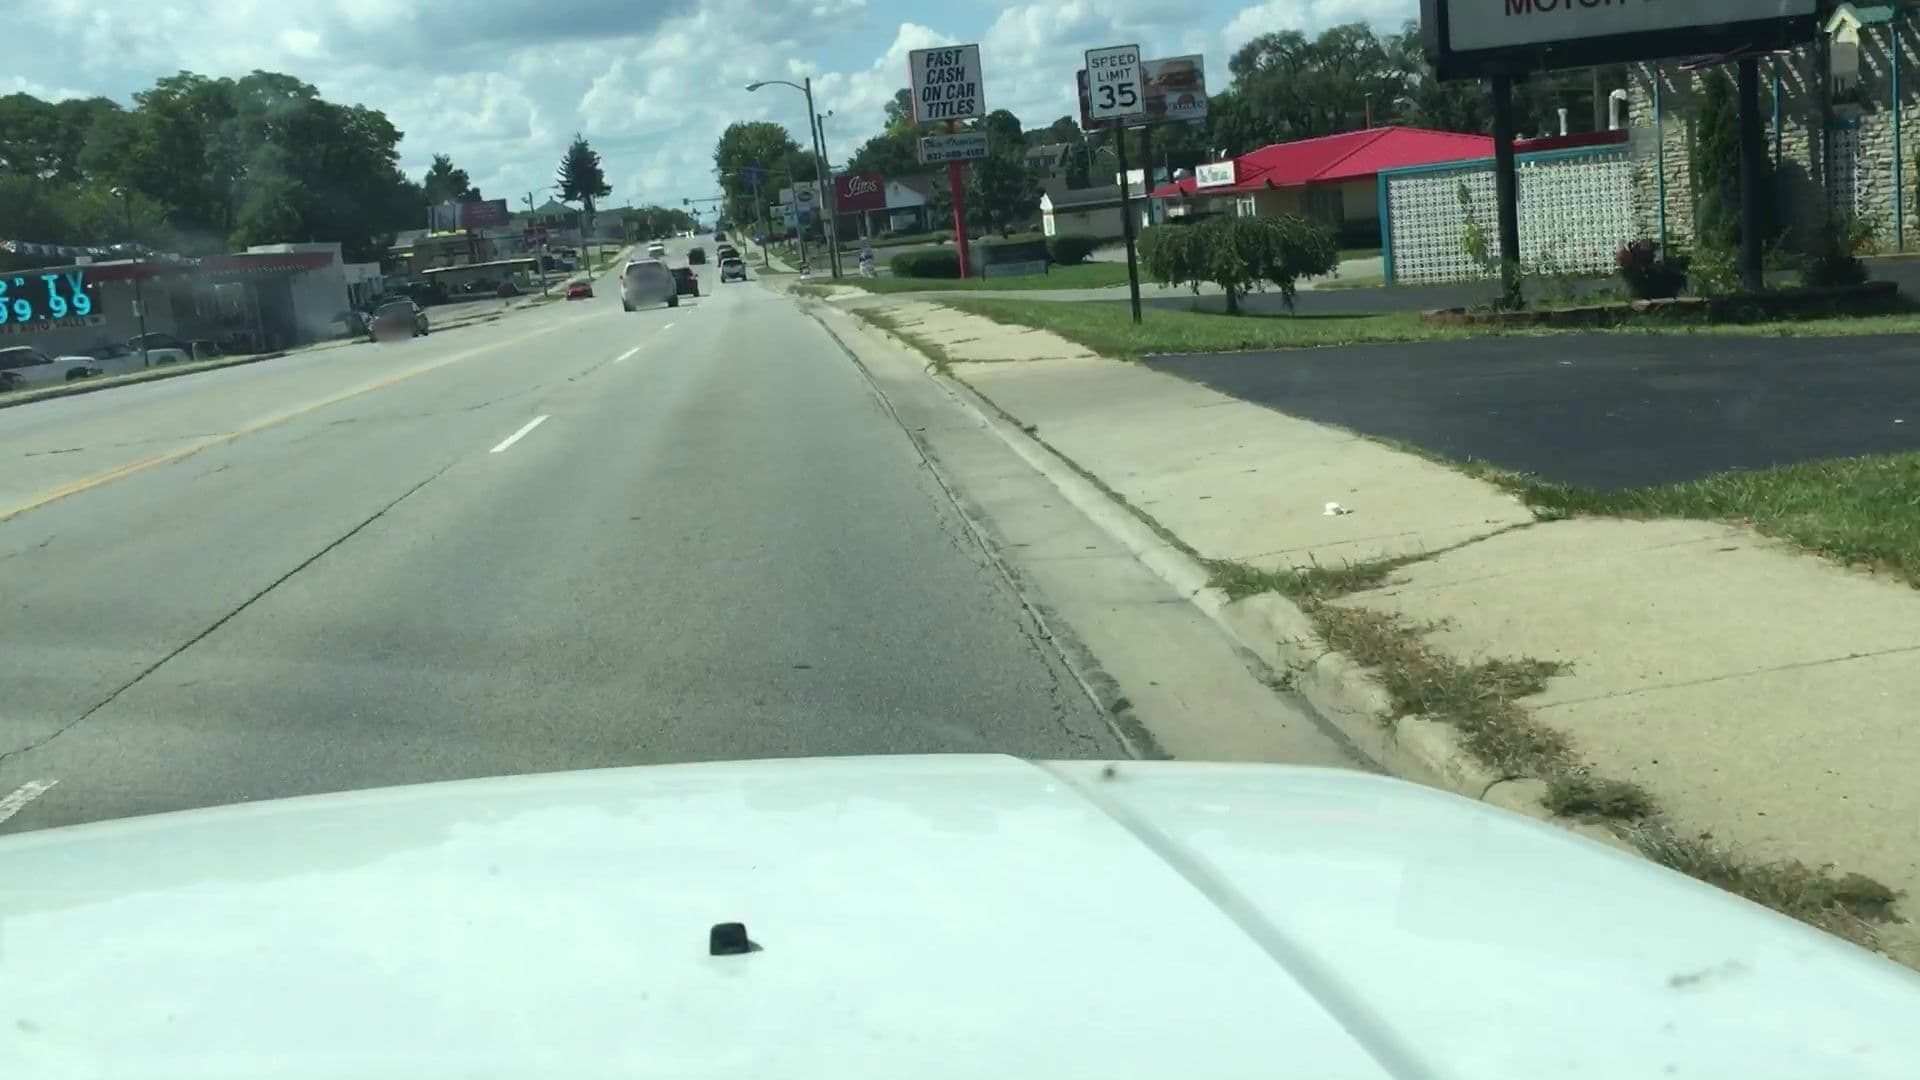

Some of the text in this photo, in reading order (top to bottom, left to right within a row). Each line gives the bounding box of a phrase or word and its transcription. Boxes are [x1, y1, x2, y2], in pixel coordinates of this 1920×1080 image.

[1504, 0, 1625, 16] MOT
[926, 50, 962, 68] FAST
[1091, 54, 1136, 69] SPEED
[926, 67, 965, 84] CASH
[1097, 68, 1132, 82] LIMIT
[922, 82, 976, 102] ON CAR
[1098, 83, 1137, 109] 35
[926, 99, 975, 118] TITLES
[40, 271, 83, 297] TV
